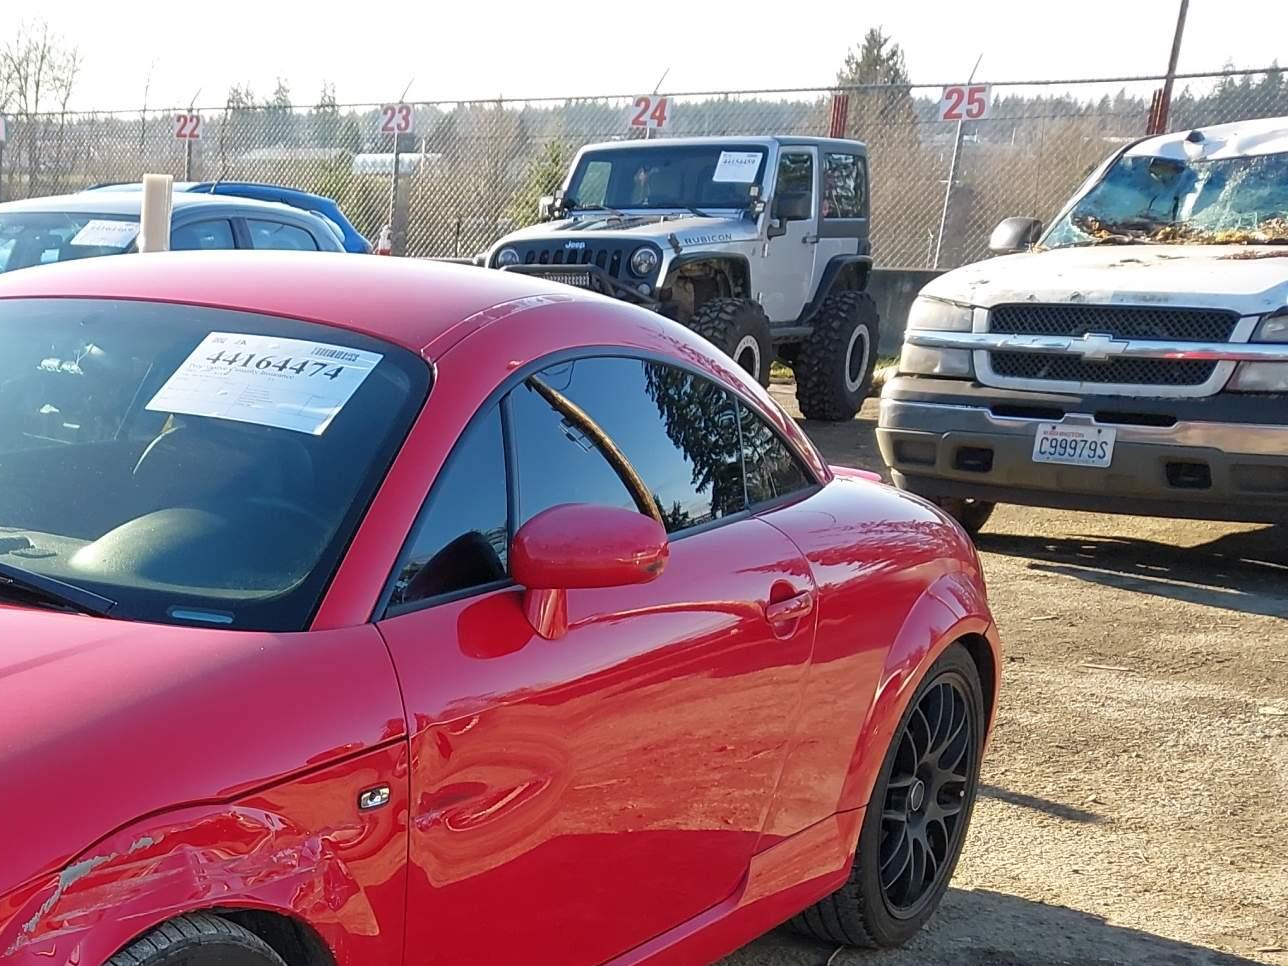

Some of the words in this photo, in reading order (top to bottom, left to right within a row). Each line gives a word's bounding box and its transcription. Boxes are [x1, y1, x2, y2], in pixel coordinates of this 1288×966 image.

[631, 96, 667, 128] 24
[943, 86, 986, 120] 25
[175, 114, 201, 138] 22
[381, 106, 412, 132] 23
[564, 239, 586, 249] Jeep
[684, 233, 732, 245] RUBICON
[206, 350, 345, 381] 44164474
[1038, 436, 1108, 460] C99979S
